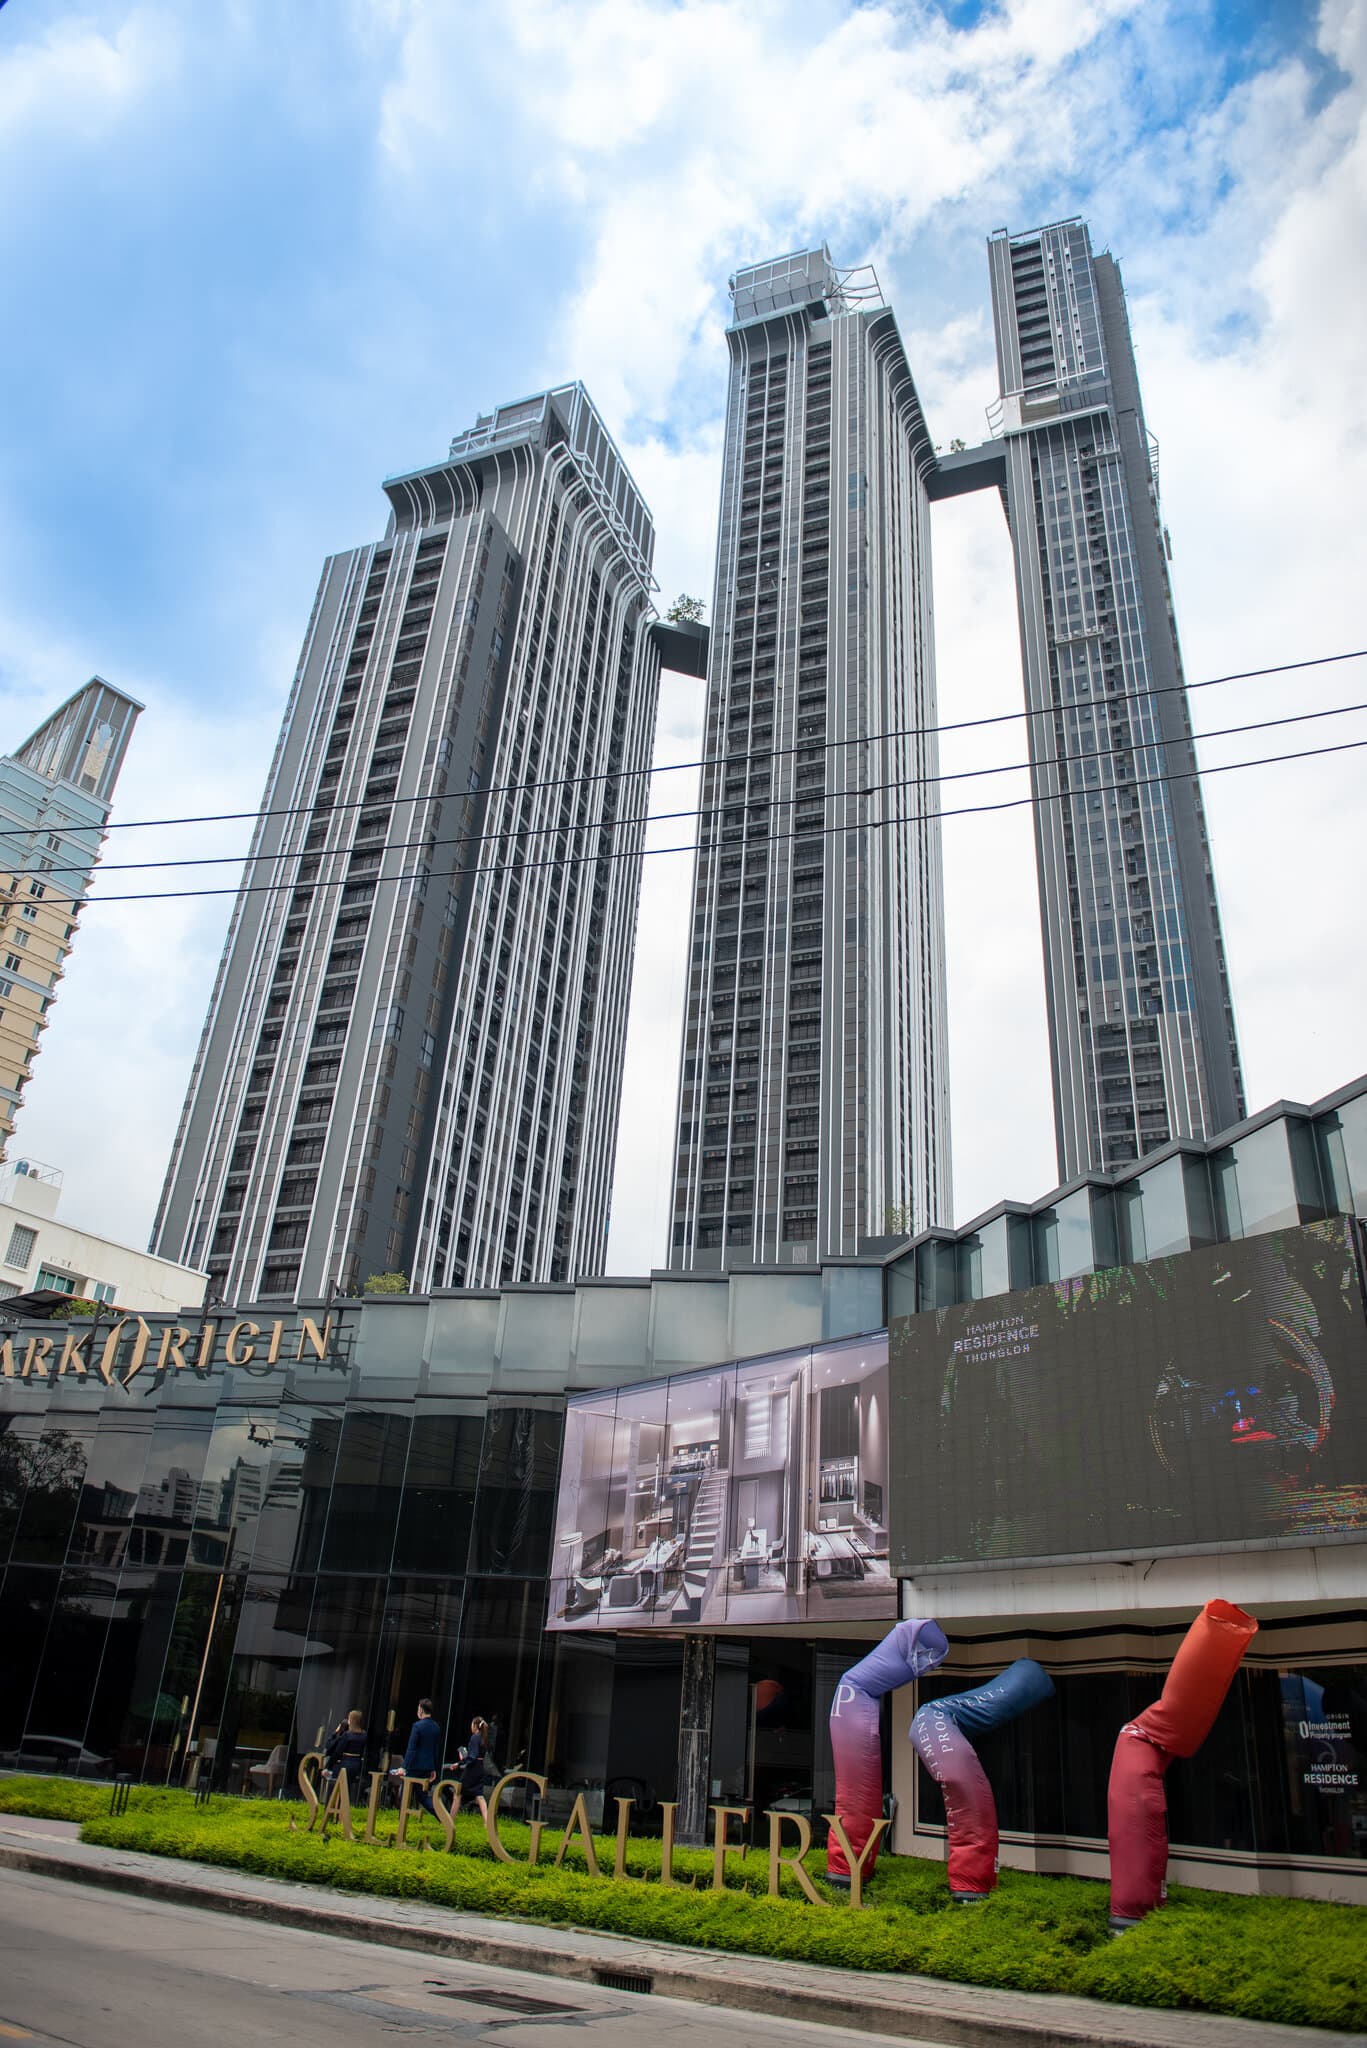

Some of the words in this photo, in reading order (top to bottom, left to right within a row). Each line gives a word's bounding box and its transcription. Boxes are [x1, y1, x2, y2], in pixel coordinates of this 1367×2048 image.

[966, 1314, 1024, 1336] HAMPTON
[1311, 1764, 1348, 1772] HAMPTON
[288, 1752, 463, 1853] SALES
[486, 1771, 893, 1910] GALLERY
